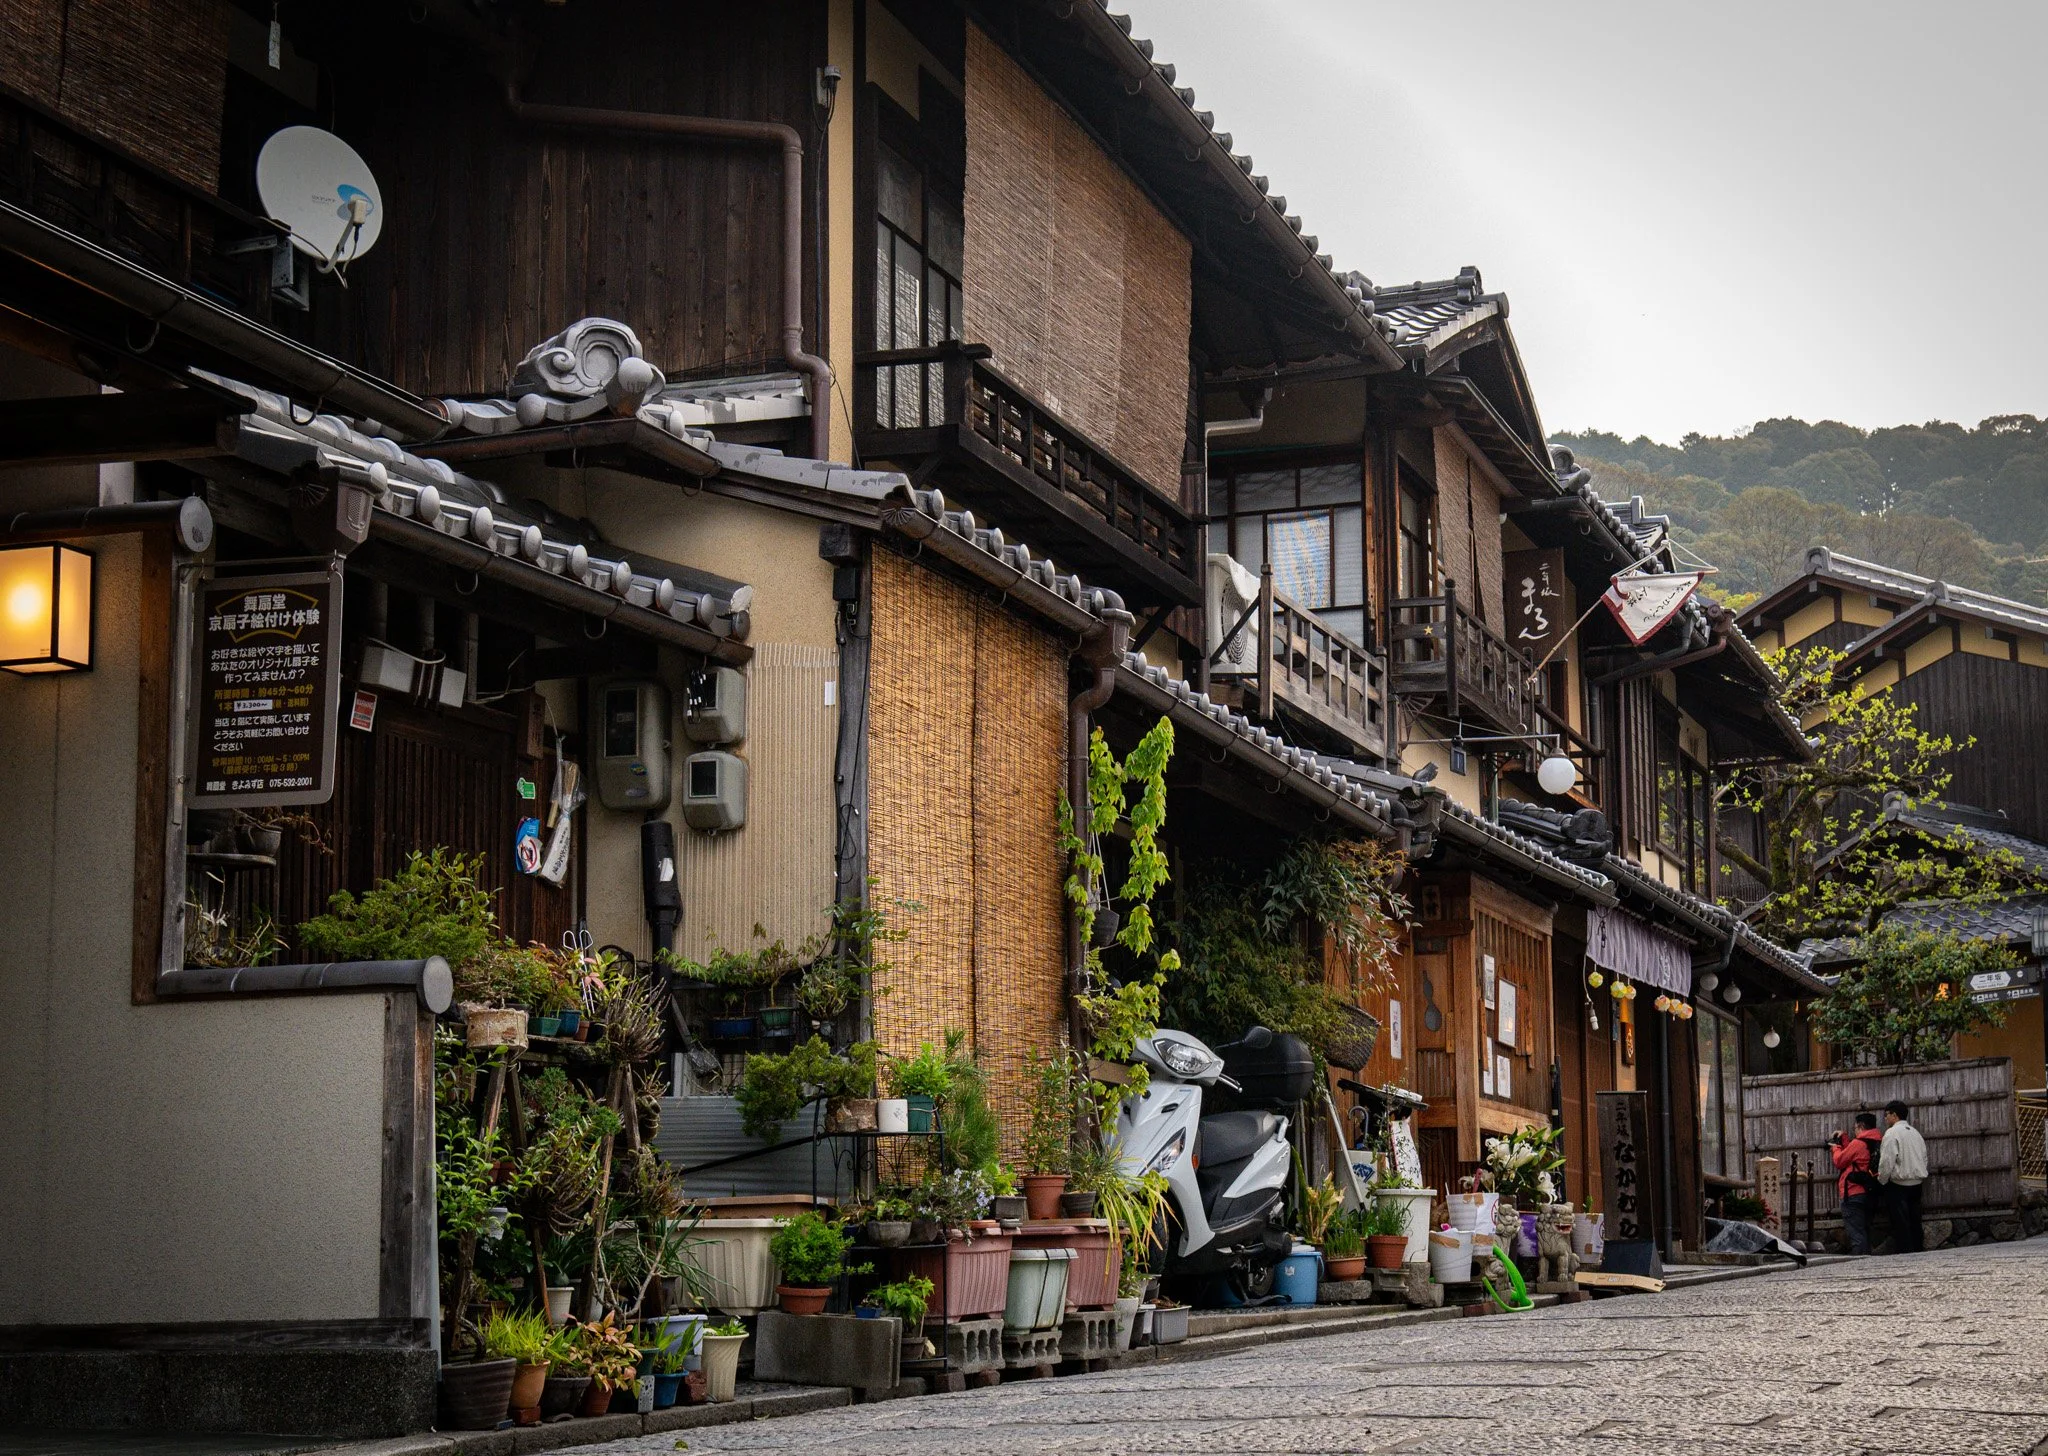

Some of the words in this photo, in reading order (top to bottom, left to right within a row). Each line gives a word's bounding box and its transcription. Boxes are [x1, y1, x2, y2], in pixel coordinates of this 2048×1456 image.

[243, 593, 287, 613] 舞扇堂
[1518, 577, 1551, 640] まるん
[208, 608, 320, 633] 京扇子絵付け体験
[211, 642, 320, 660] お好きな絵や文字を描いて
[210, 655, 320, 672] あなたのオリジナル扇子を
[224, 668, 306, 684] 作ってみませんか？
[213, 725, 310, 740] どうぞお気軽にお問い合わせ
[213, 742, 244, 752] ください
[231, 779, 264, 791] きよみず店
[269, 777, 313, 788] 075-532-2001
[1615, 1102, 1630, 1137] 二年坂
